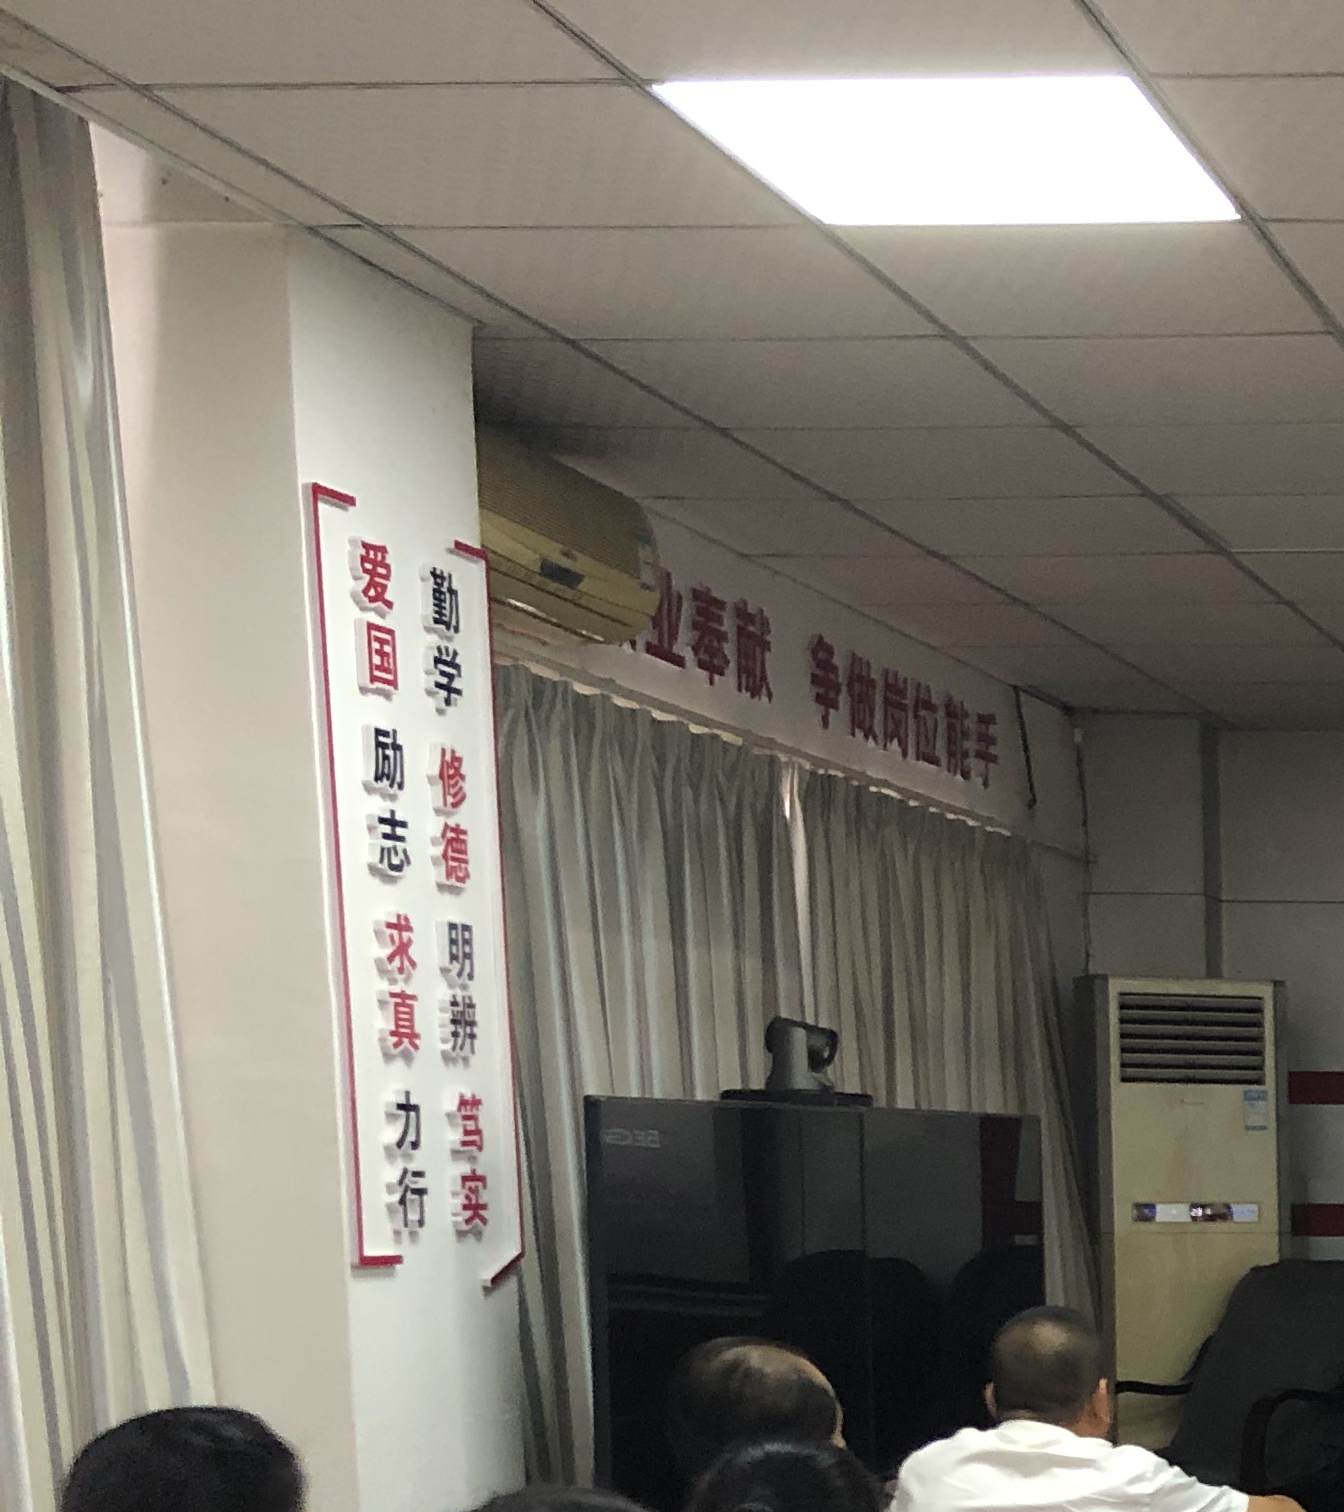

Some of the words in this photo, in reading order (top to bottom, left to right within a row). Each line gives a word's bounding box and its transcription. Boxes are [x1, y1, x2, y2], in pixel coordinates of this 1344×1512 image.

[356, 540, 399, 694] 爱国
[430, 567, 464, 710] 勤学
[629, 571, 774, 704] 业奉献
[808, 633, 1000, 790] 争做岗位能手
[372, 726, 411, 876] 励志
[437, 748, 471, 891] 修德
[382, 913, 421, 1054] 求真
[446, 920, 478, 1055] 明辨
[394, 1091, 428, 1230] 力行
[456, 1091, 489, 1230] 笃实
